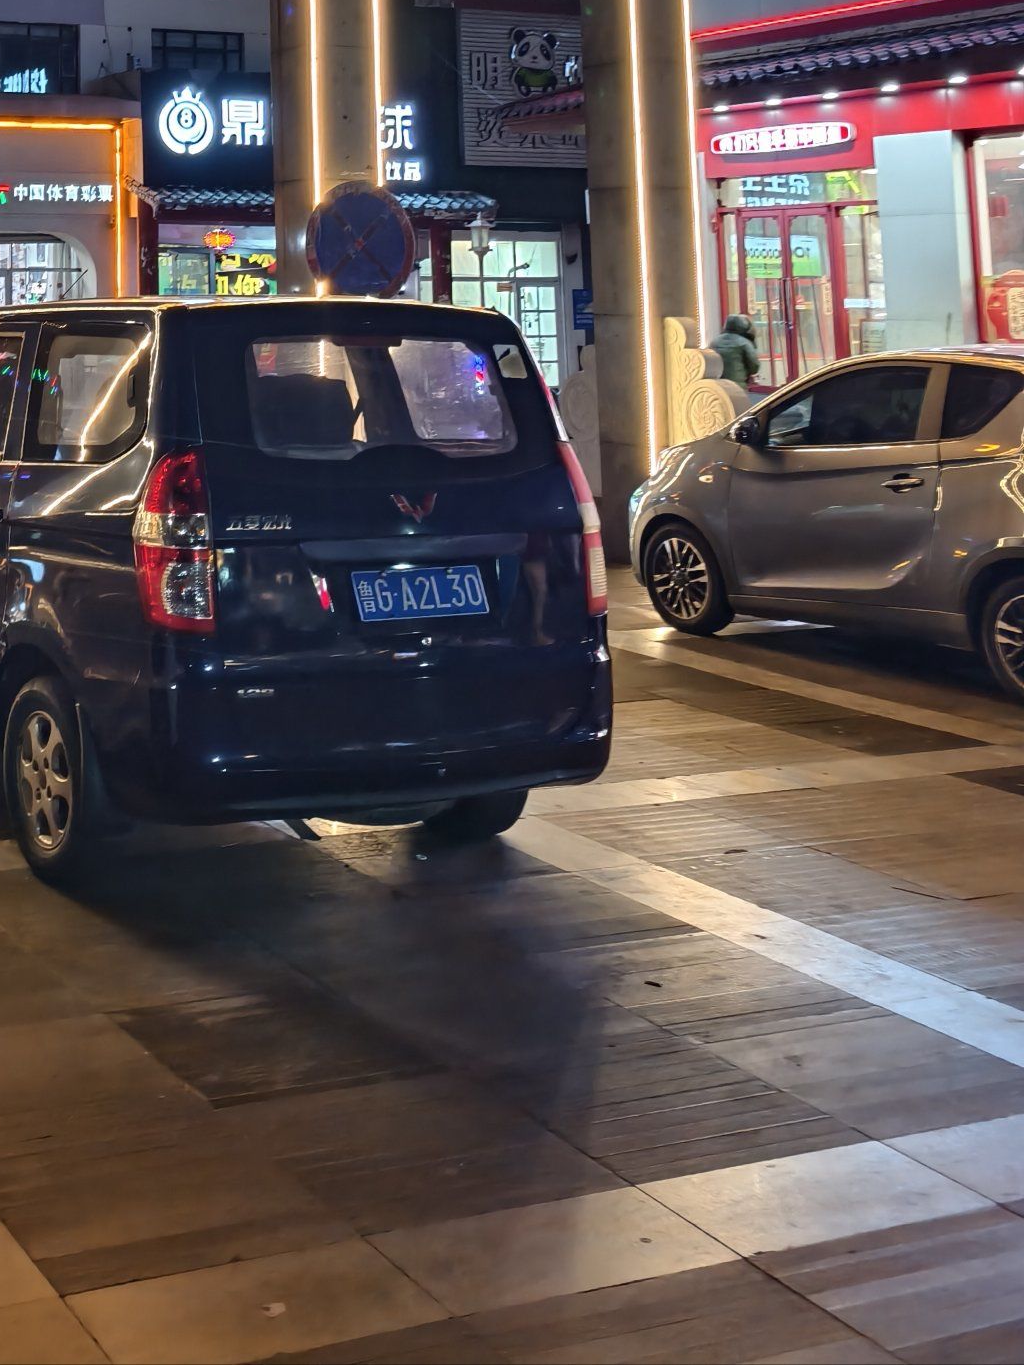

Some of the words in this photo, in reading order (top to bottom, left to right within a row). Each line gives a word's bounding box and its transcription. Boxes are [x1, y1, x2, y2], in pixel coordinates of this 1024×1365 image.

[221, 98, 266, 146] 鼎
[13, 183, 113, 203] 中国体育彩票
